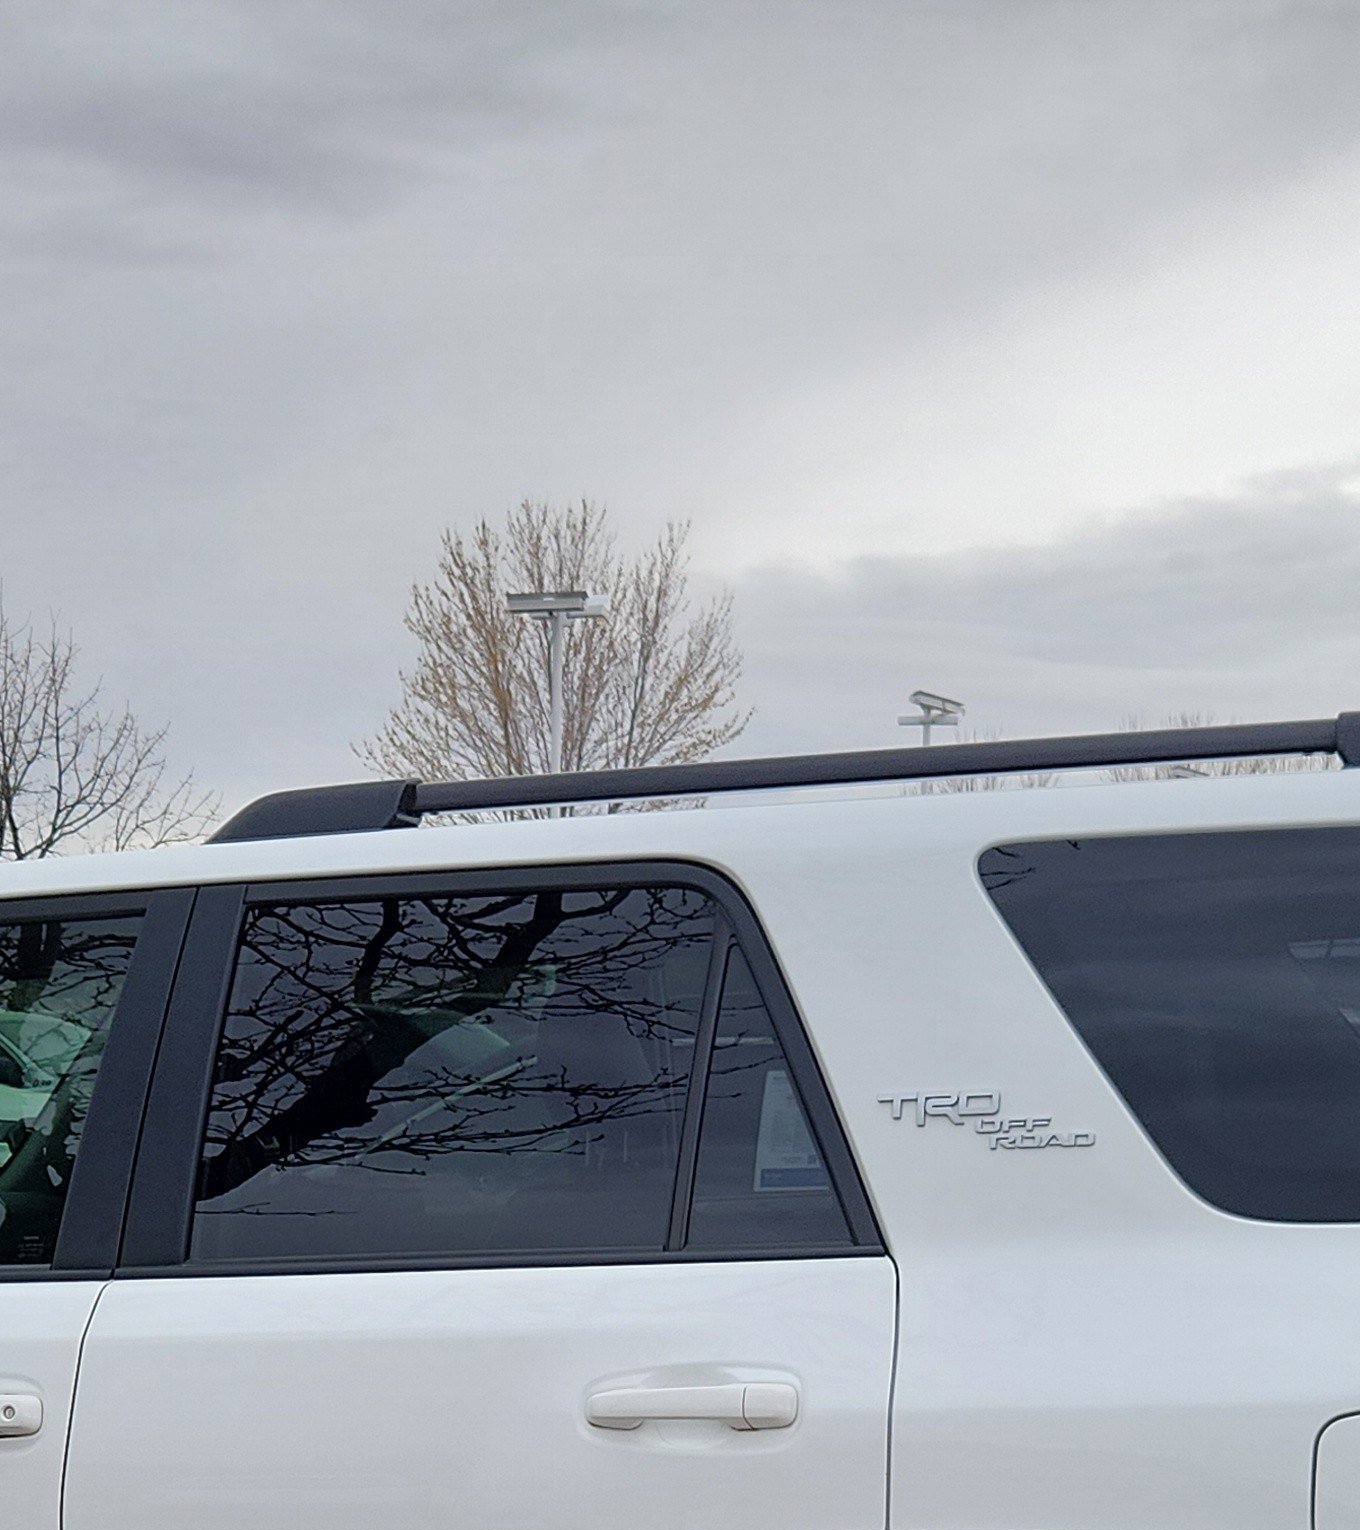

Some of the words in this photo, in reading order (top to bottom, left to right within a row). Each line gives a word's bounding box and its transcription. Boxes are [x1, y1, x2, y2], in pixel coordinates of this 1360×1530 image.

[877, 1089, 1001, 1127] TRD
[975, 1117, 1052, 1134] OFF
[990, 1131, 1096, 1150] ROAD
